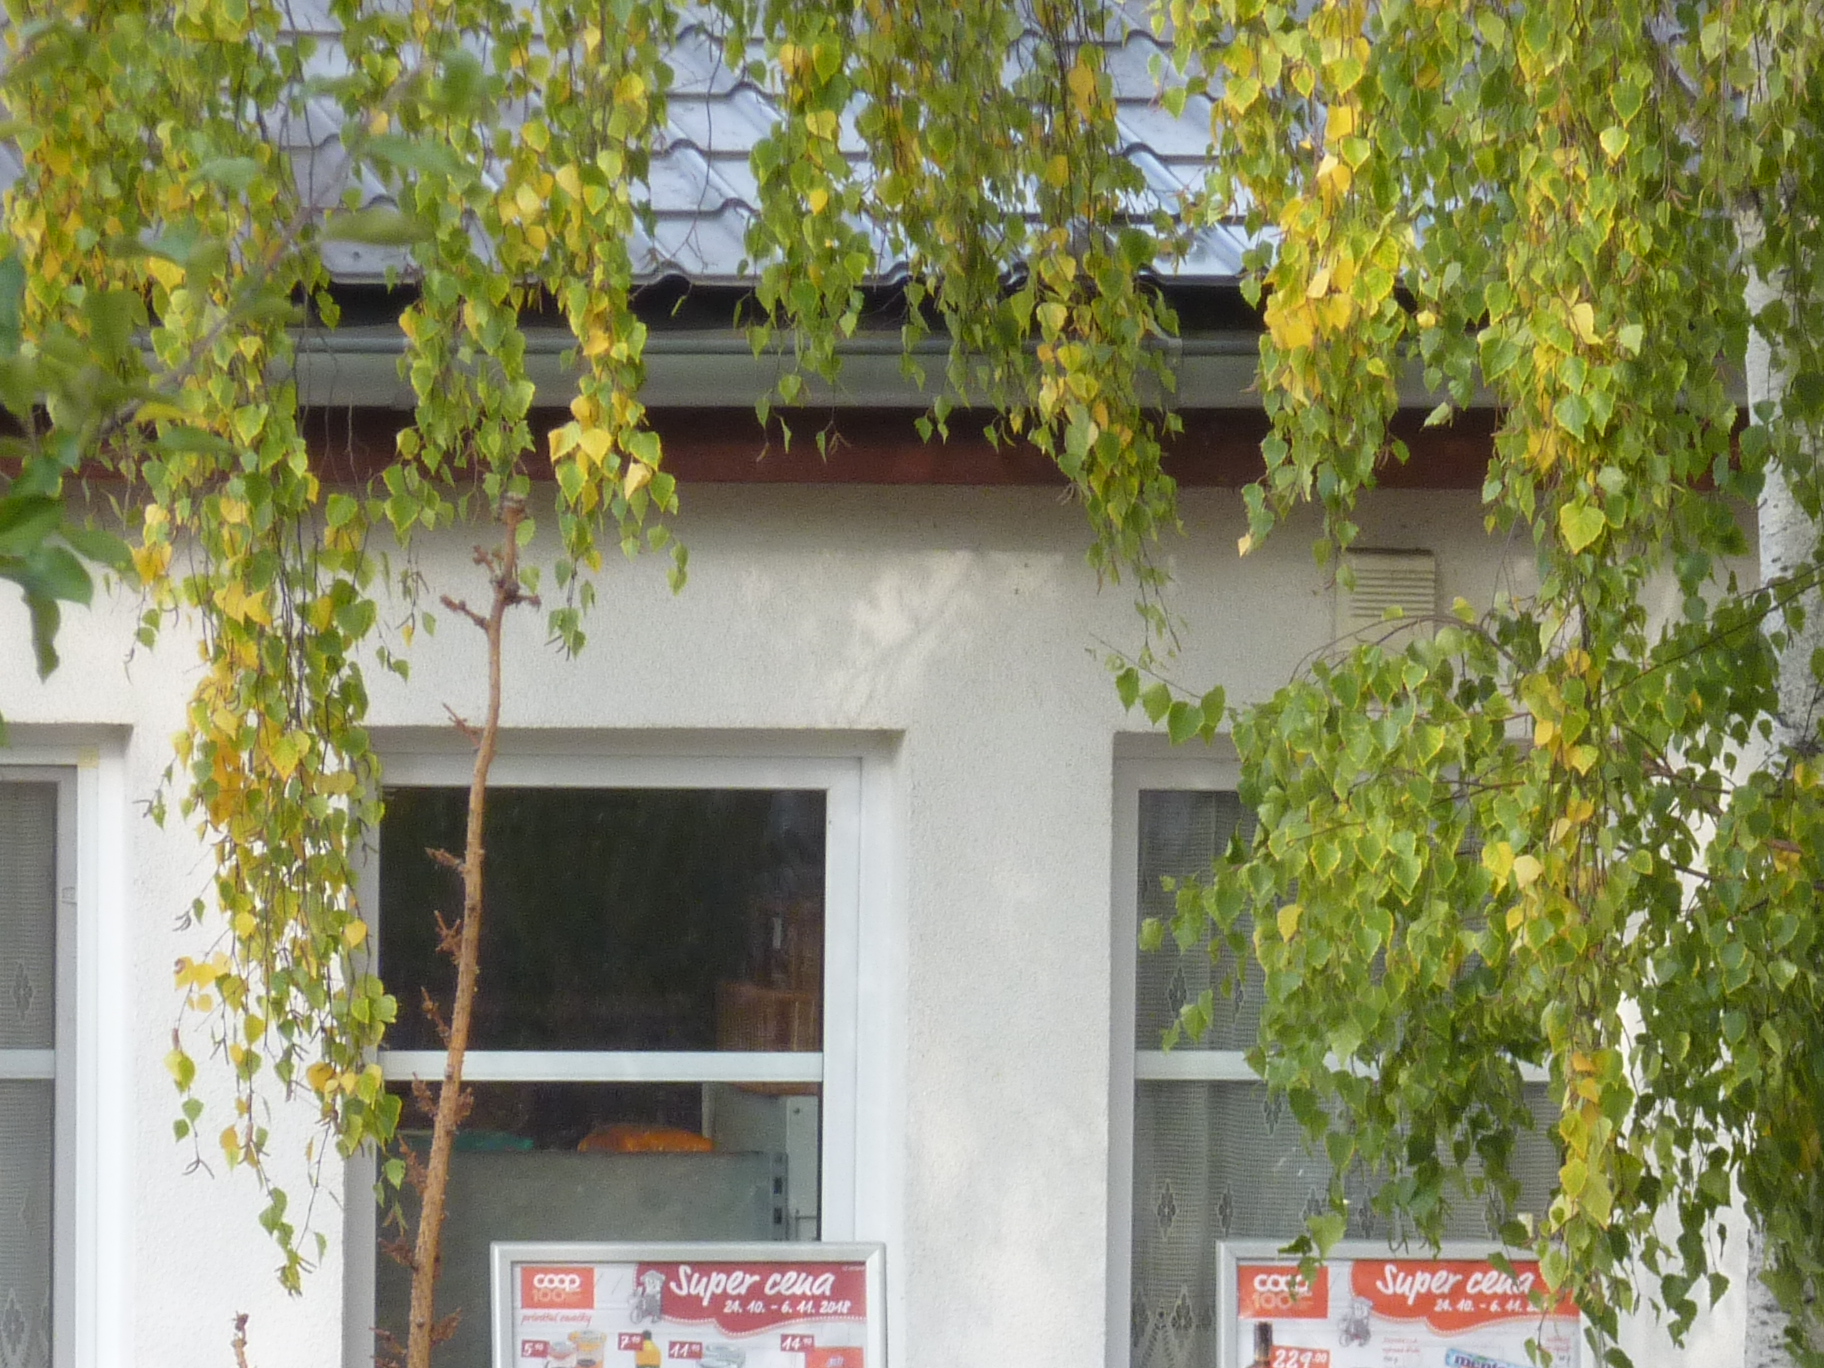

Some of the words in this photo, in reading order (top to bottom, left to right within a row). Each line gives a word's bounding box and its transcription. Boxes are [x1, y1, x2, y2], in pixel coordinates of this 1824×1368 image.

[533, 1273, 581, 1292] coop
[670, 1265, 759, 1307] Super
[764, 1272, 836, 1297] cena
[1376, 1264, 1462, 1306] Super
[1466, 1269, 1534, 1294] cena
[532, 1289, 564, 1302] 100
[819, 1300, 851, 1314] 2018
